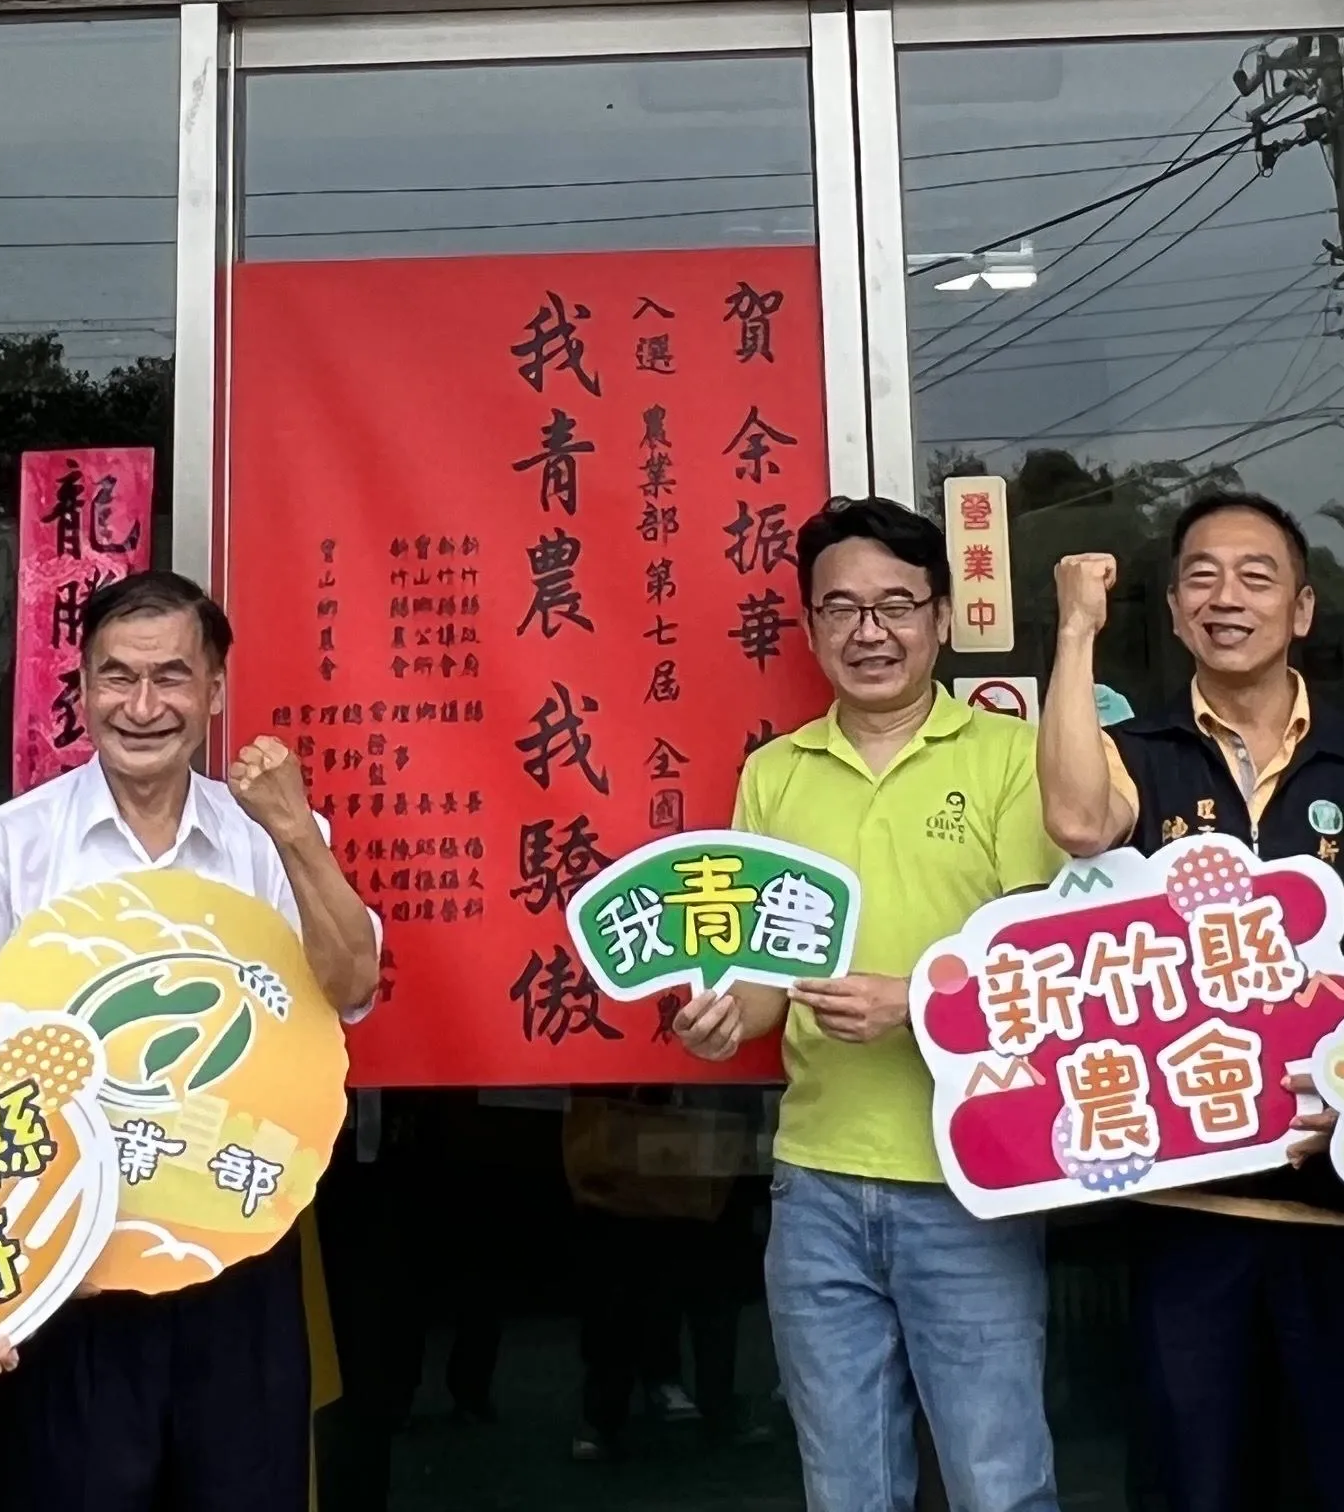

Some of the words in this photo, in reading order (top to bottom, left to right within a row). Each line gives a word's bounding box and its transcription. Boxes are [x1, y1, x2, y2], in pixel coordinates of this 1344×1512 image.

[960, 492, 994, 636] 營業中
[596, 853, 836, 976] 我青農
[982, 898, 1306, 1054] 新竹縣
[1063, 1026, 1264, 1158] 農會
